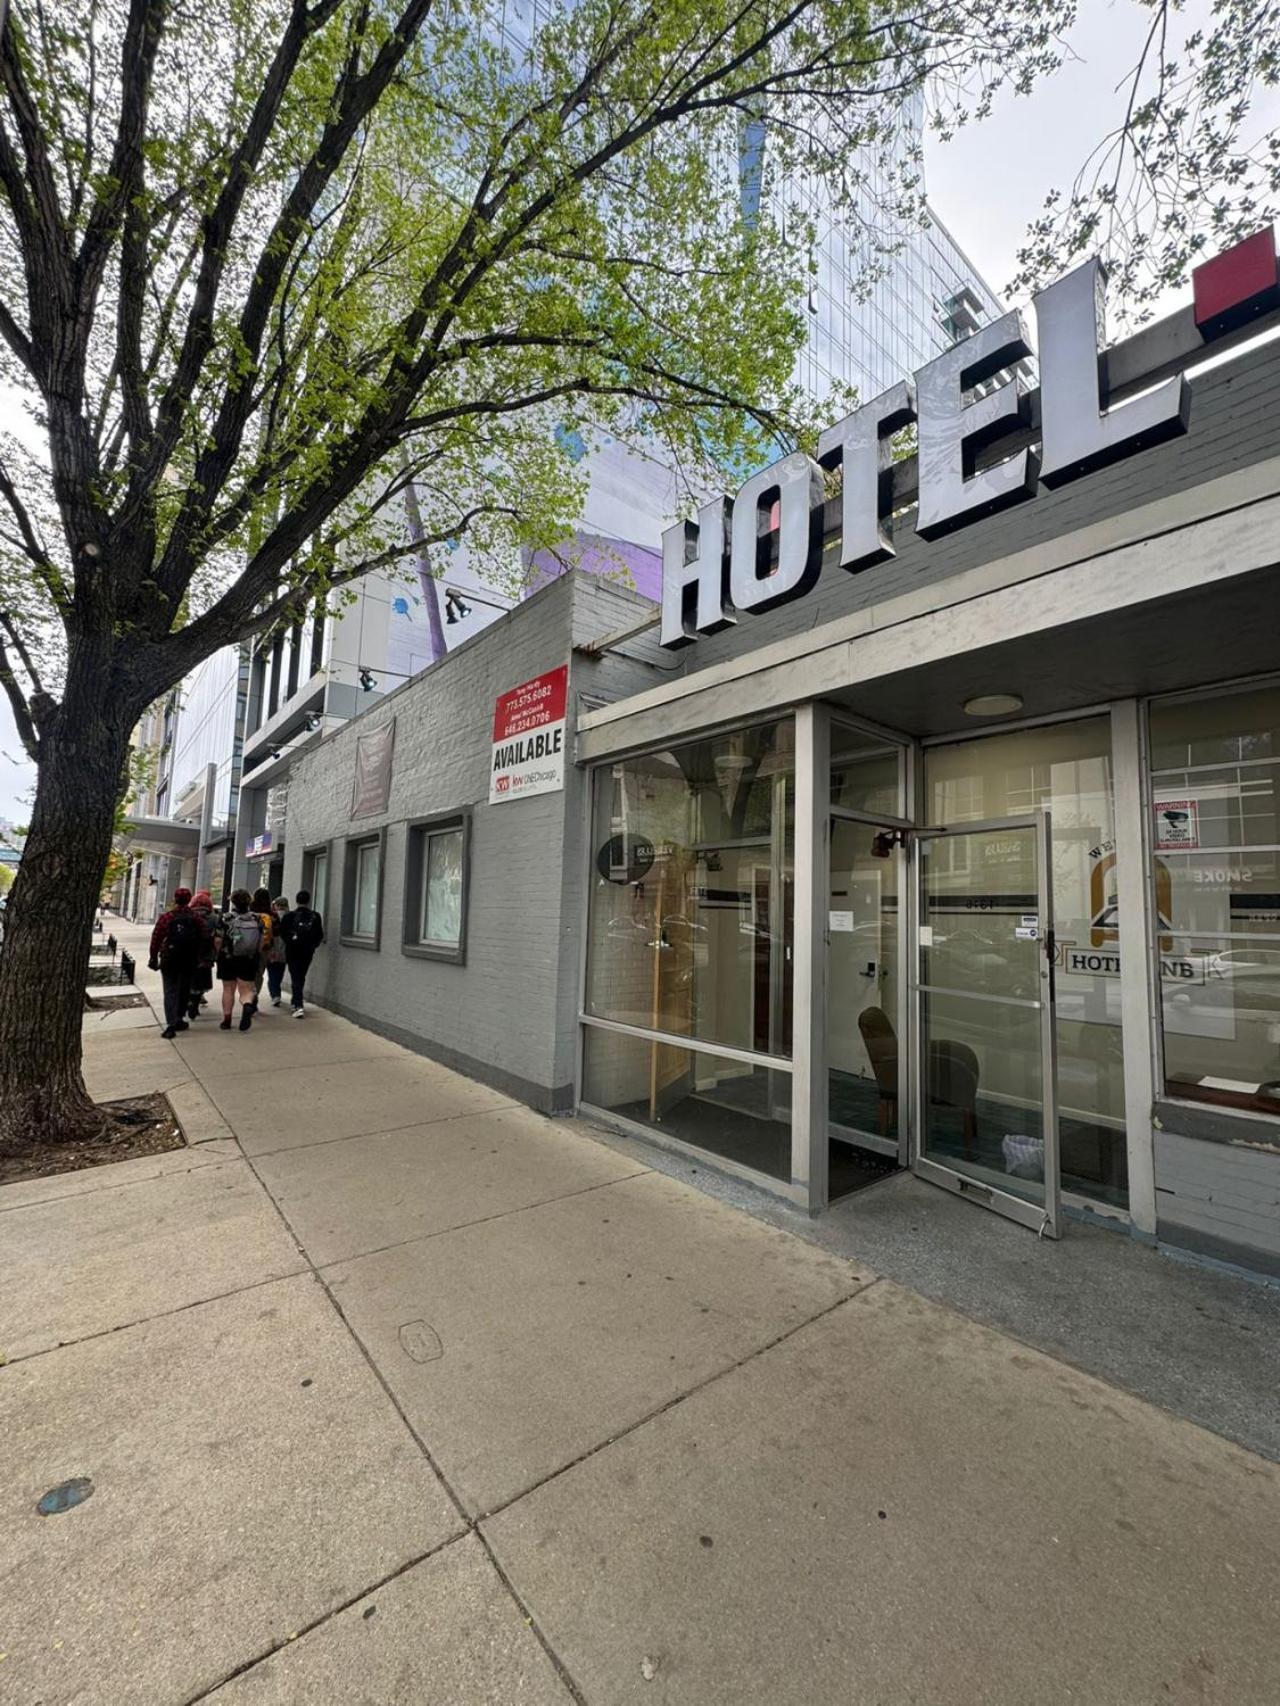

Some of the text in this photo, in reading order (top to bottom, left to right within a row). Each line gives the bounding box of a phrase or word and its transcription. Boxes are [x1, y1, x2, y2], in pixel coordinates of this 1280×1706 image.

[659, 257, 1190, 649] HOTEL
[493, 728, 562, 771] AVAILABLE
[1088, 840, 1116, 858] WE
